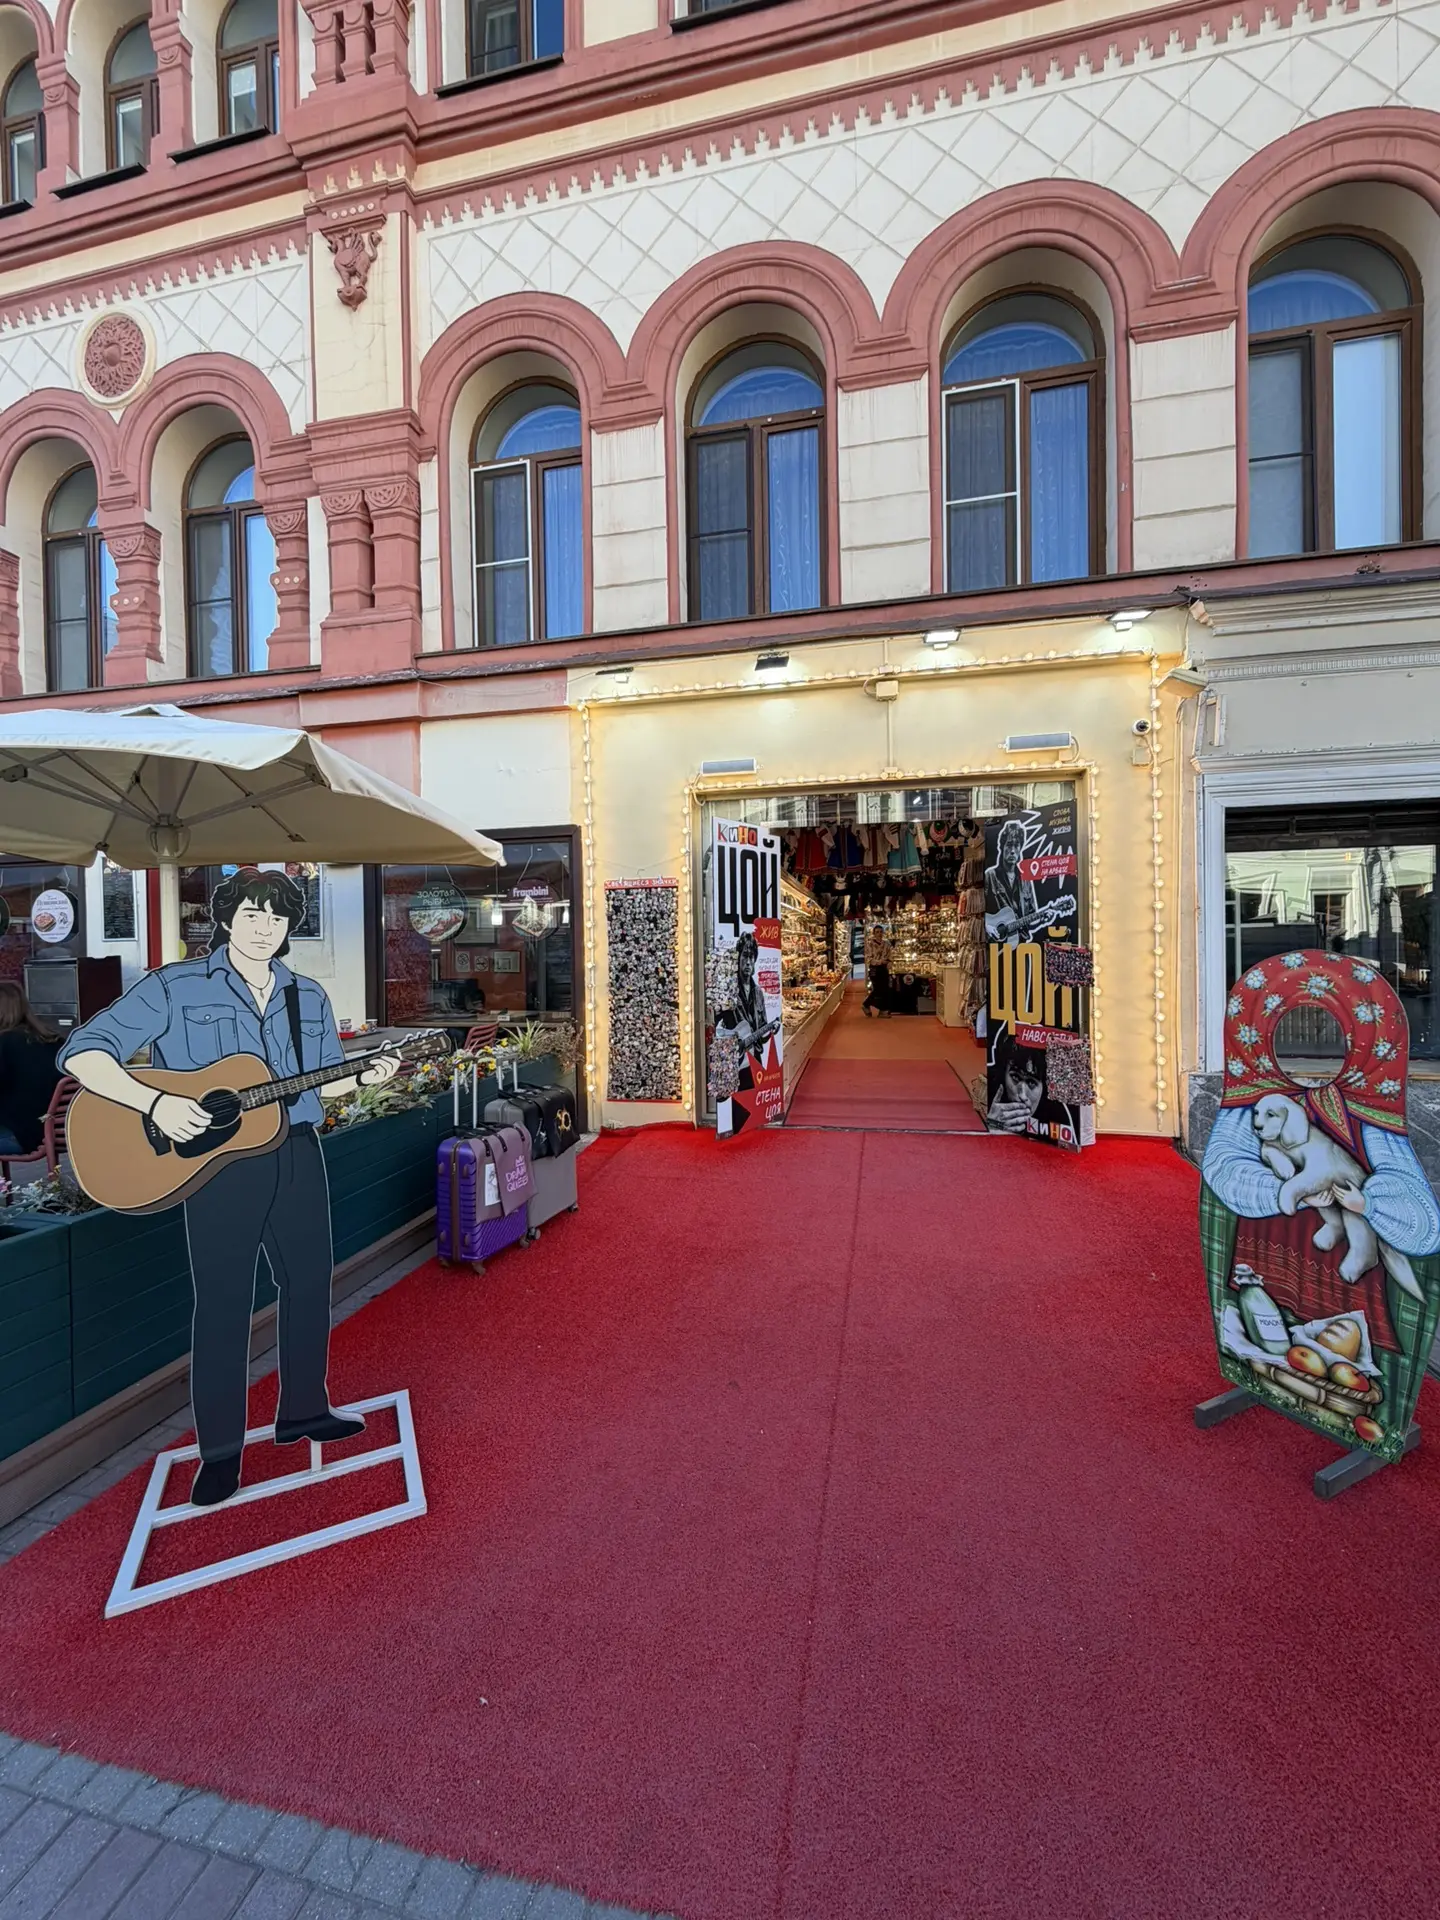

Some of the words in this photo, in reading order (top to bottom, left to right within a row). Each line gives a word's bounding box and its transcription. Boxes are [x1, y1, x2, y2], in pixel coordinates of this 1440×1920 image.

[717, 823, 758, 846] КИНО
[1041, 859, 1057, 867] СТЕНА
[417, 889, 455, 899] ЗОЛОТАЯ
[513, 886, 549, 897] frambini
[717, 838, 778, 937] ЦОЙ
[422, 898, 450, 906] РЫБКА
[760, 925, 779, 939] ЖИВ
[990, 926, 1073, 1035] ЦОЙ
[755, 1087, 781, 1106] СТЕНА
[1026, 1116, 1073, 1143] КИНО
